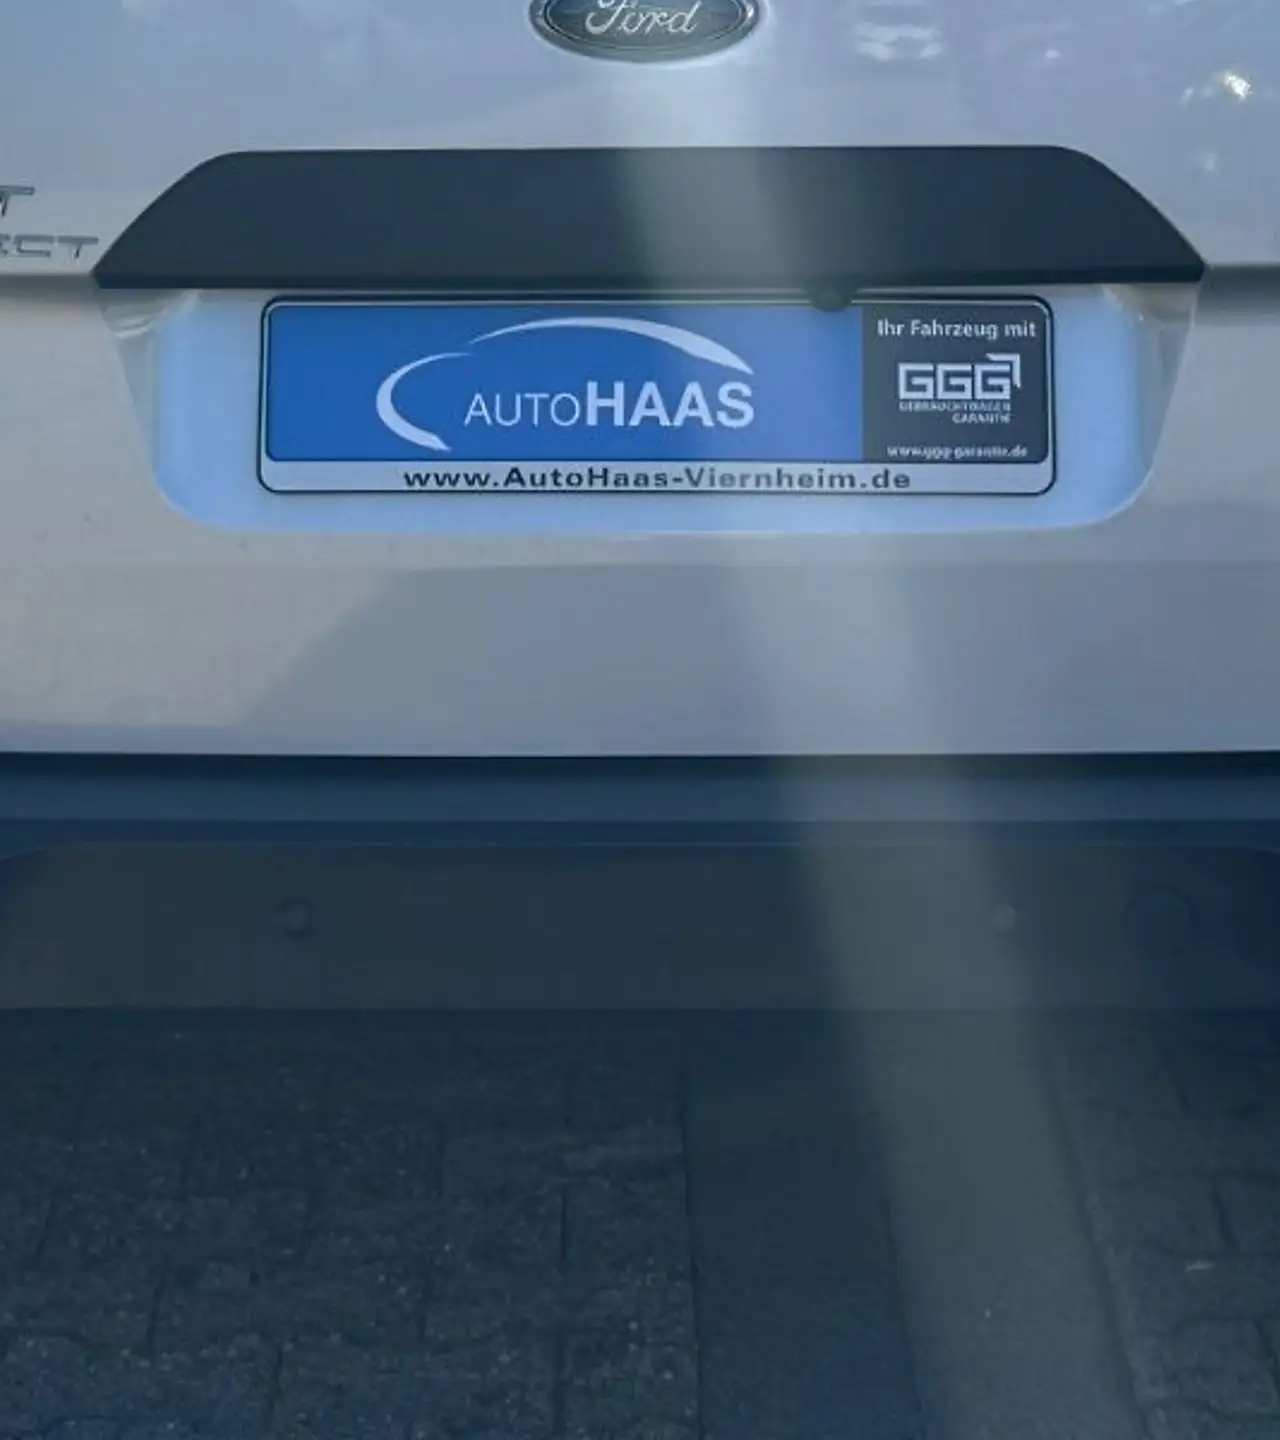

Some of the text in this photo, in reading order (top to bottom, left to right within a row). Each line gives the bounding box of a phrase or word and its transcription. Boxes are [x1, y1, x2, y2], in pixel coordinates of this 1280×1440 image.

[877, 318, 1036, 340] Ihr Fahrzeug mit
[898, 363, 1011, 400] GGG
[404, 466, 911, 489] www.AutoHaas-Viernheim.de
